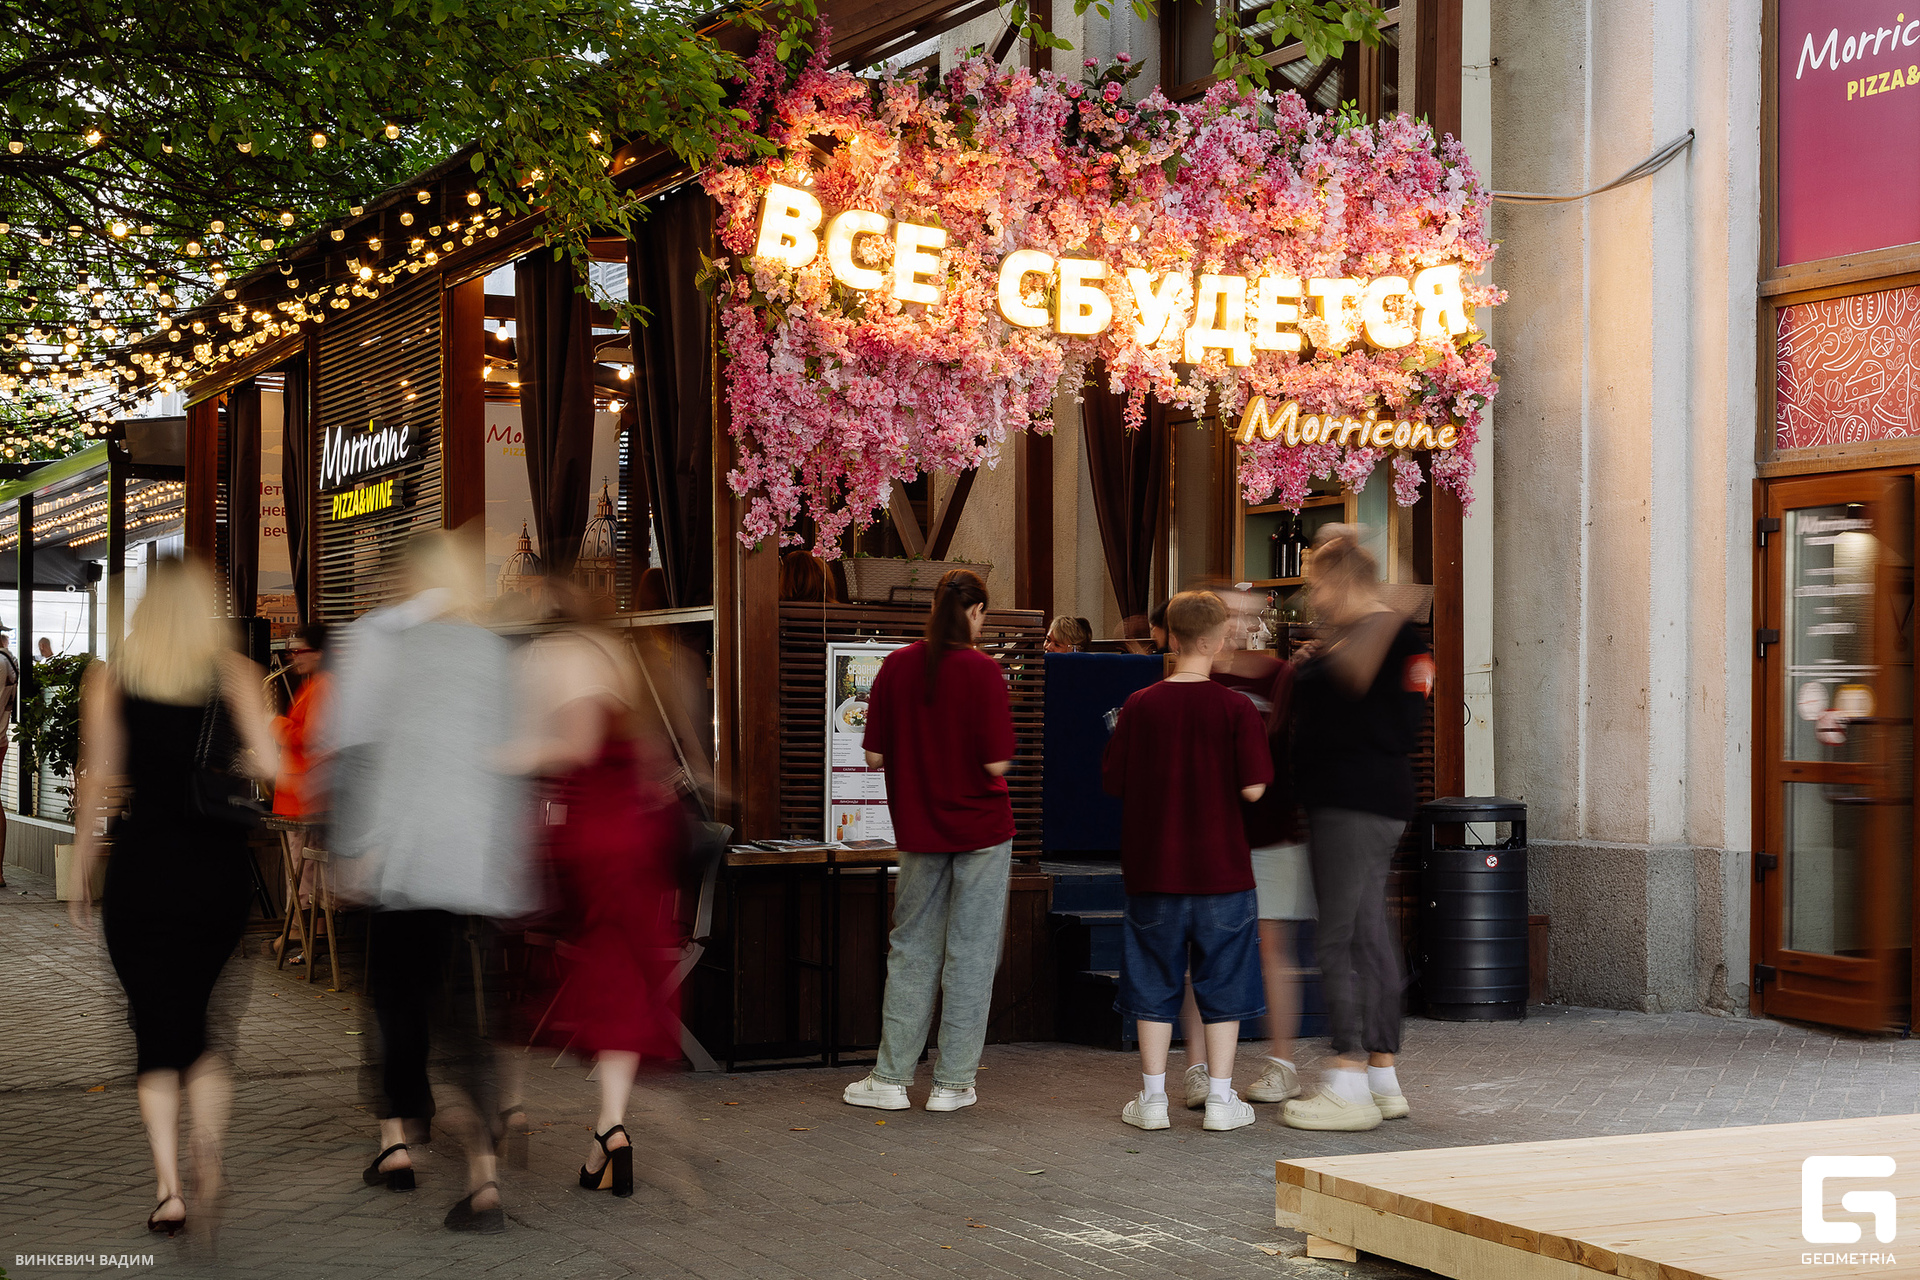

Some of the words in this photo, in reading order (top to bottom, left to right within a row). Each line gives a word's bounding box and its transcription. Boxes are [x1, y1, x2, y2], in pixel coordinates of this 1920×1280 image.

[1795, 12, 1920, 80] Morric
[757, 182, 948, 306] ВСЕ
[998, 249, 1468, 367] СБУДЕТСЯ
[486, 423, 526, 445] Mo
[1237, 396, 1458, 449] Morricone
[320, 419, 410, 490] Morricone
[332, 479, 394, 521] PIZZA&WINE
